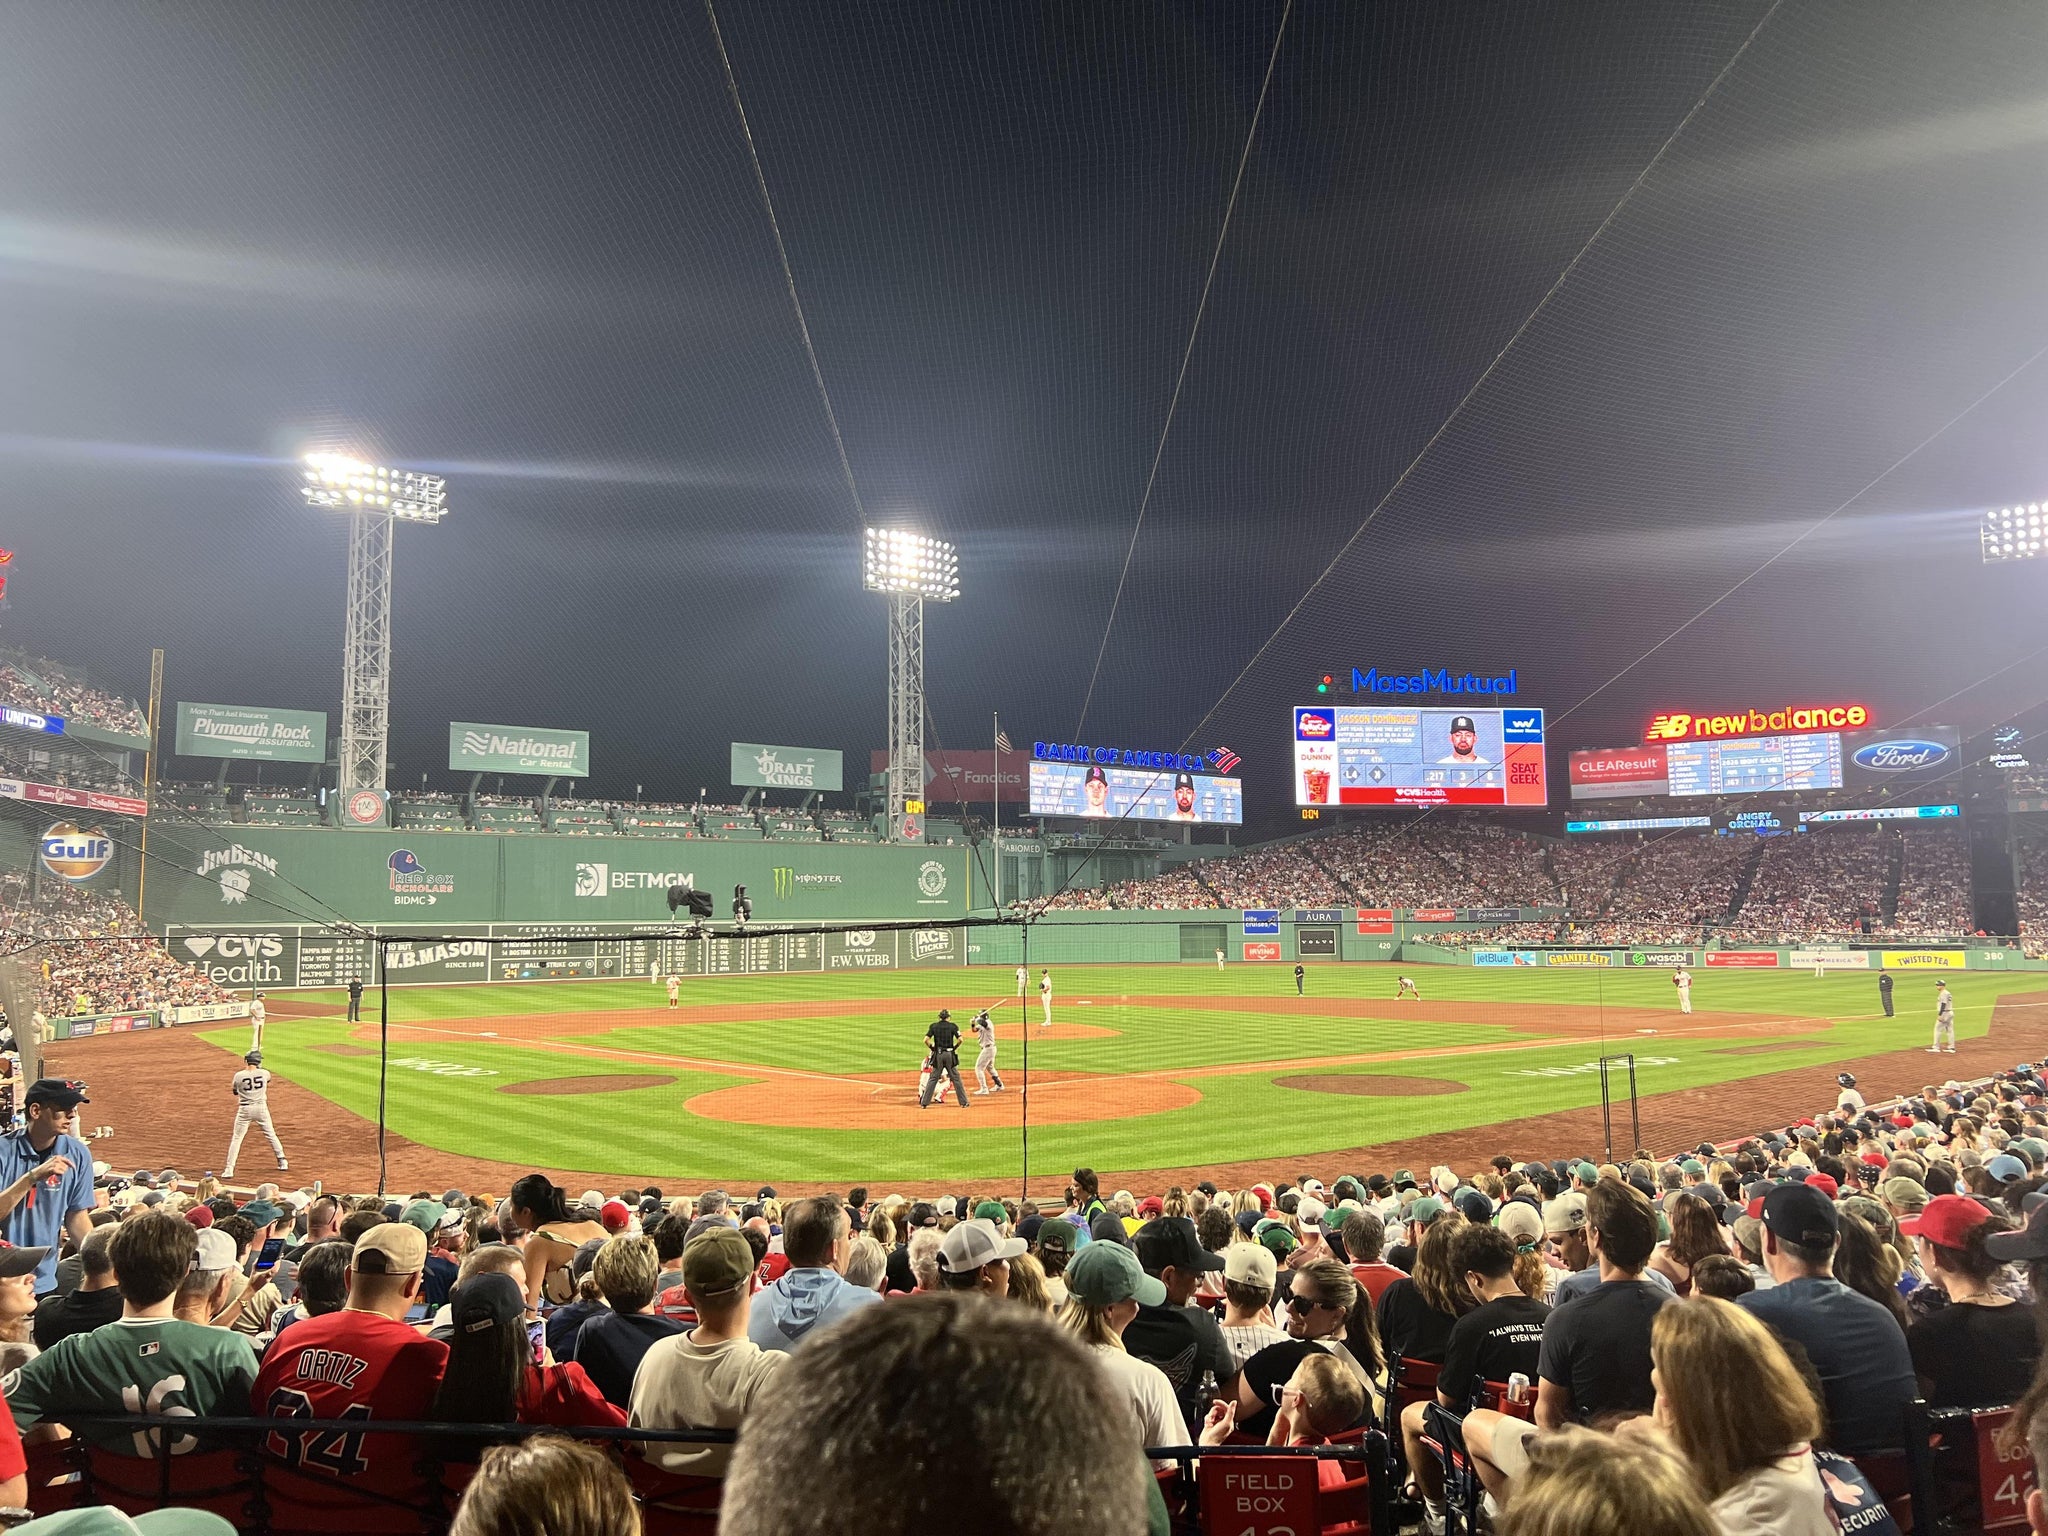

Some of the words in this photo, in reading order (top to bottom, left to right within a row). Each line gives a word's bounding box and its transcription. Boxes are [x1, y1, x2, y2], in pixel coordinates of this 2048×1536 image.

[1352, 668, 1517, 694] MassMutual
[193, 718, 268, 737] Plymouth
[272, 723, 312, 740] Rock
[258, 737, 312, 748] assurance
[488, 736, 576, 759] National
[1034, 741, 1090, 762] BANK
[1093, 746, 1119, 764] OF
[1122, 749, 1206, 770] AMERICA
[1871, 745, 1930, 766] Ford
[520, 758, 538, 766] Car
[540, 759, 572, 768] Rental
[758, 760, 815, 776] DRAFT
[1511, 762, 1538, 773] SEAT
[1580, 758, 1657, 772] CLEAResult
[765, 772, 814, 786] KINGS
[964, 771, 1021, 784] Fanatics
[1510, 774, 1540, 784] GEEK
[1736, 812, 1772, 820] ANGRY
[1728, 818, 1780, 828] ORCHARD
[42, 838, 109, 858] Gulf
[1005, 844, 1040, 853] ABIOMED
[395, 874, 424, 884] RED
[426, 874, 454, 884] SOX
[612, 872, 694, 888] BETMGM
[394, 884, 454, 893] SCHOLARS
[394, 896, 426, 905] BIDMC
[1431, 911, 1455, 920] TICKET
[919, 931, 949, 944] ACE
[218, 934, 282, 958] CVS
[920, 942, 949, 954] TICKET
[1378, 942, 1391, 950] 420
[386, 942, 488, 968] W.B.MASON
[831, 955, 852, 967] F.W.
[855, 954, 890, 966] WEBB
[1476, 954, 1508, 964] jetBlue
[1550, 953, 1588, 964] GRANITE
[1590, 952, 1610, 964] CITY
[1646, 952, 1688, 962] wasabi
[1897, 955, 1933, 966] TWISTED
[1934, 956, 1949, 966] TEA
[1984, 952, 2003, 960] 380
[187, 960, 282, 983] Health
[504, 969, 518, 978] 24
[242, 1076, 263, 1091] 35
[1496, 1324, 1524, 1336] ALWAYS
[1524, 1324, 1542, 1332] TELL
[1510, 1334, 1530, 1343] EVEN
[297, 1348, 368, 1390] ORTIZ
[266, 1386, 373, 1475] 34
[1226, 1474, 1294, 1490] FIELD
[1236, 1497, 1285, 1512] BOX
[1840, 1504, 1890, 1533] ECURITY
